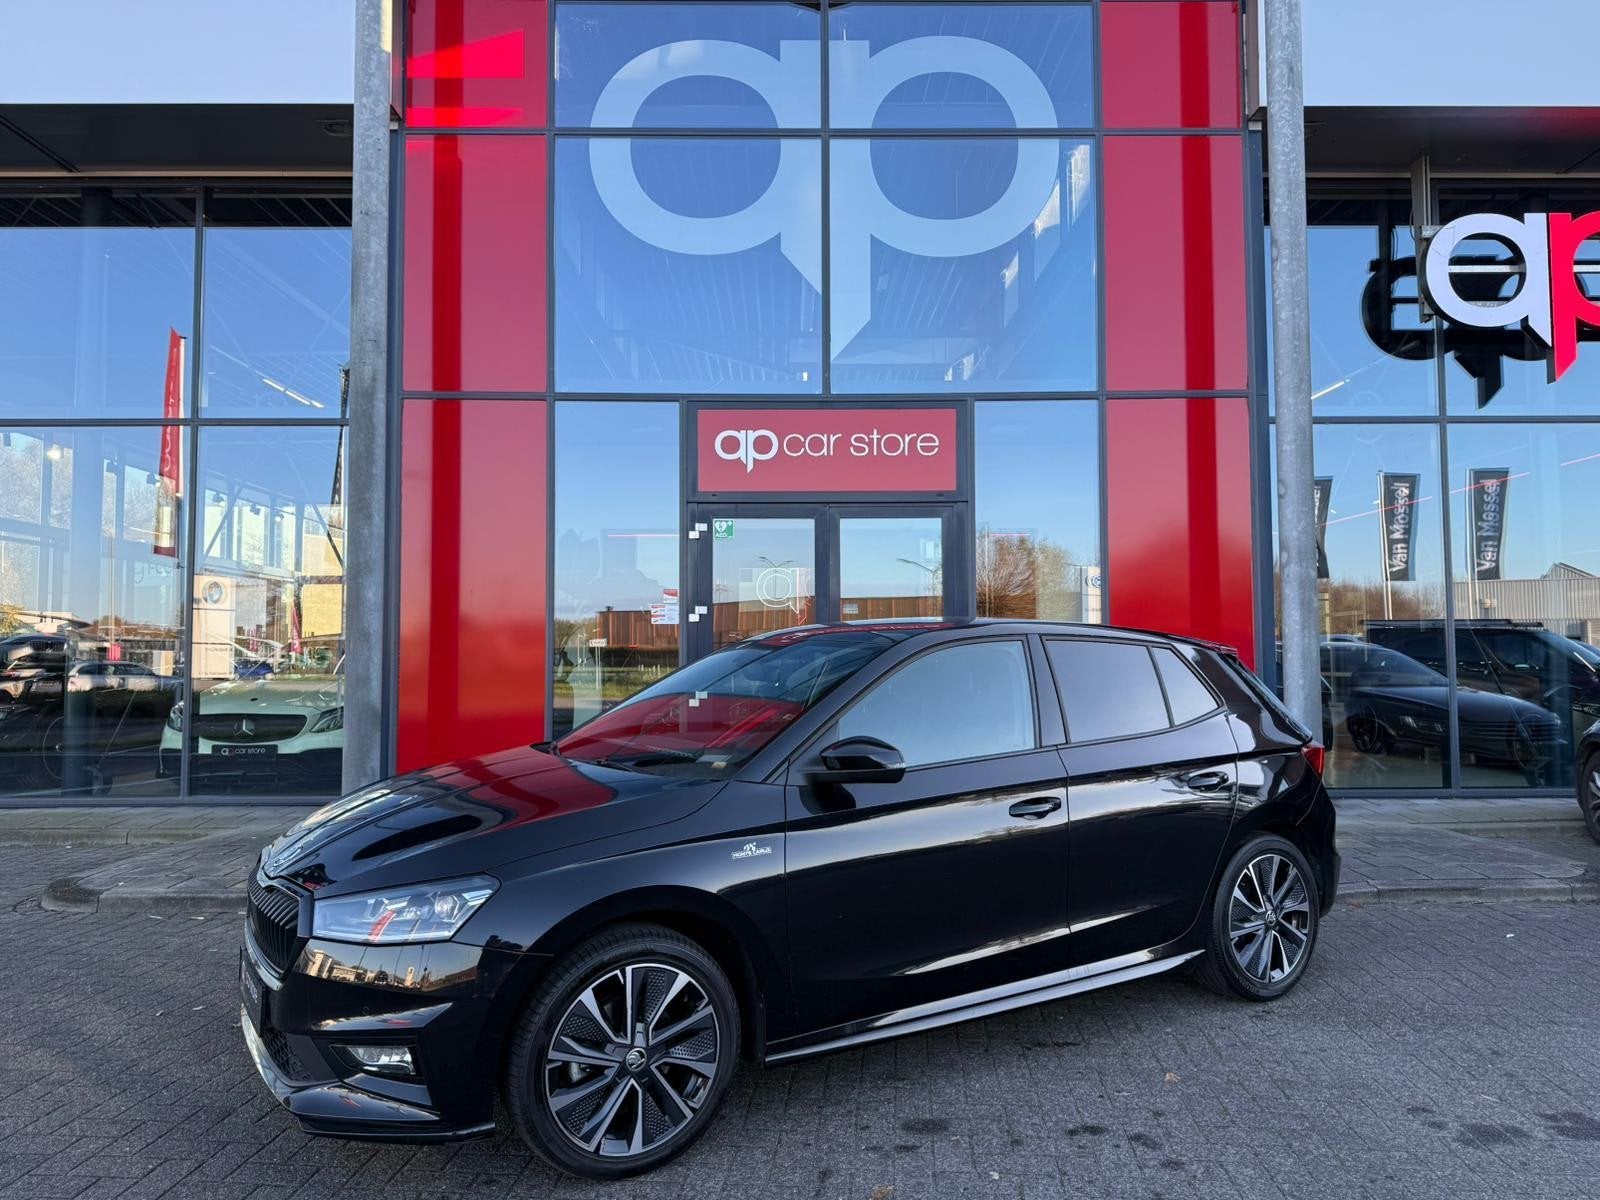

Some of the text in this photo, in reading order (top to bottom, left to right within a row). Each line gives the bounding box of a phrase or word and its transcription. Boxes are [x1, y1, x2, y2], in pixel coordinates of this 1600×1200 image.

[714, 428, 940, 473] ap car store
[1389, 482, 1410, 572] Van Mossel
[1476, 479, 1500, 571] Van Mossel
[732, 847, 770, 858] MONTE CARLO
